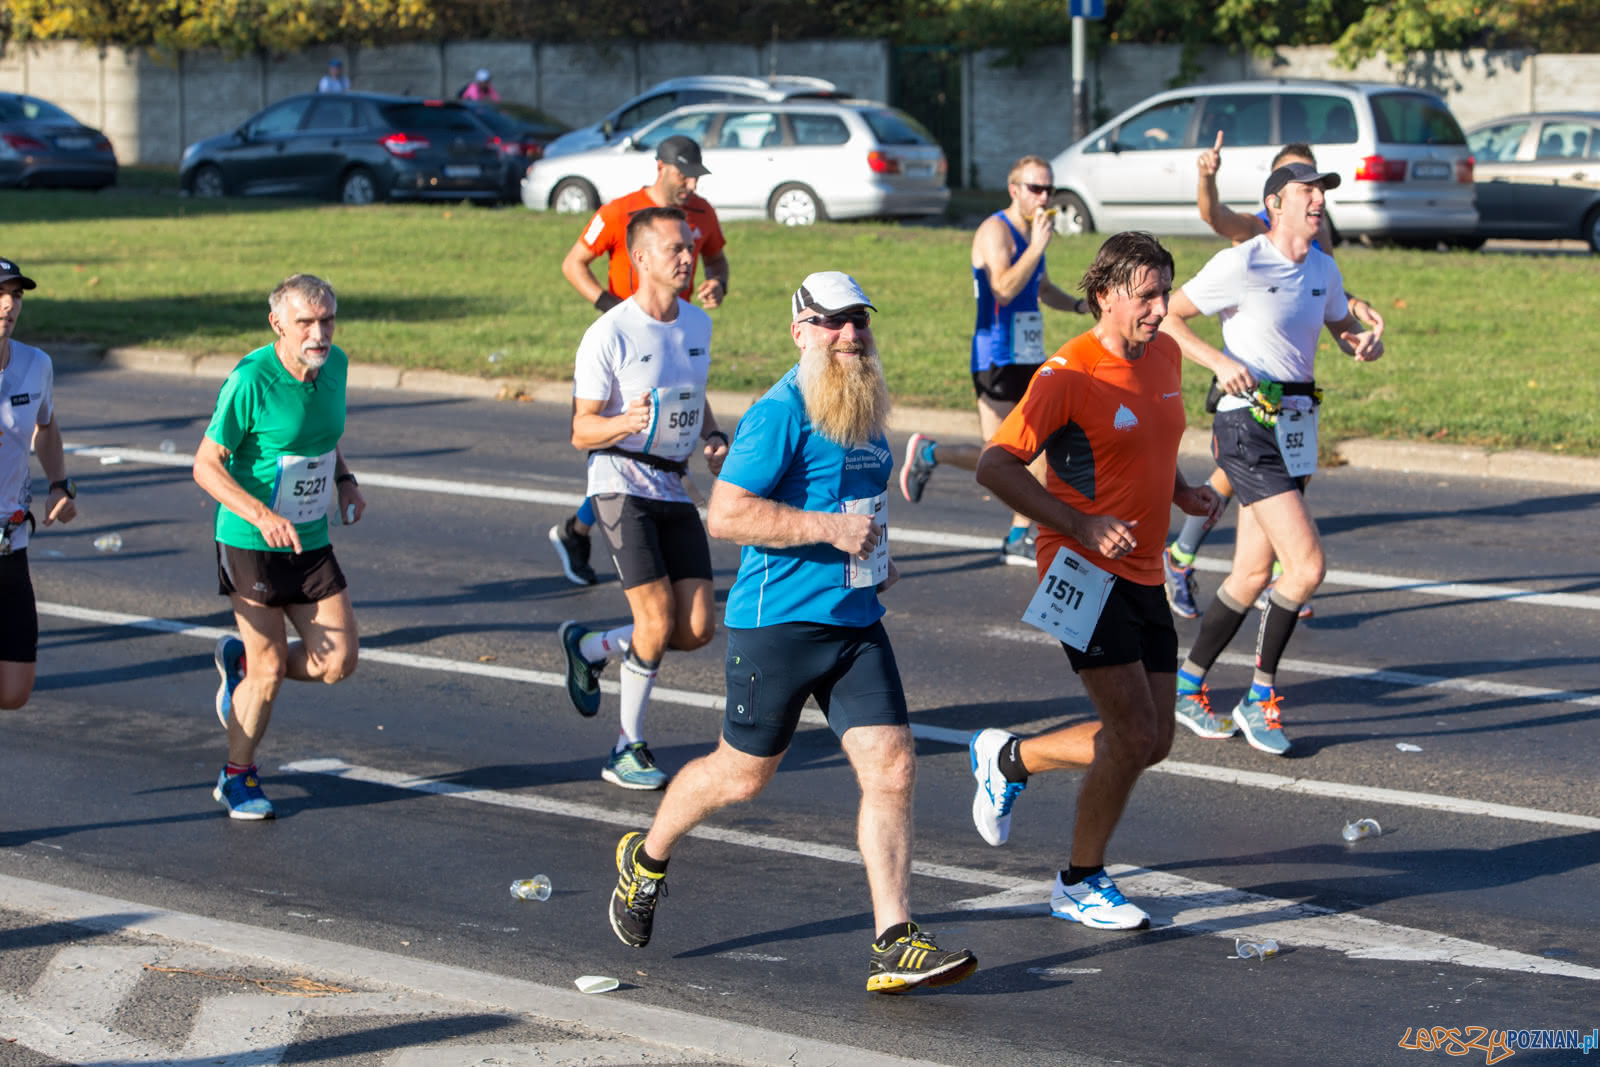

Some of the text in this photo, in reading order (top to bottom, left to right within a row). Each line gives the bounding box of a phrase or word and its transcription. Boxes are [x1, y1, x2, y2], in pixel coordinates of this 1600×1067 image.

[669, 408, 699, 429] 5081
[1286, 432, 1304, 449] 552
[293, 476, 327, 496] 5221
[1045, 575, 1084, 611] 1511
